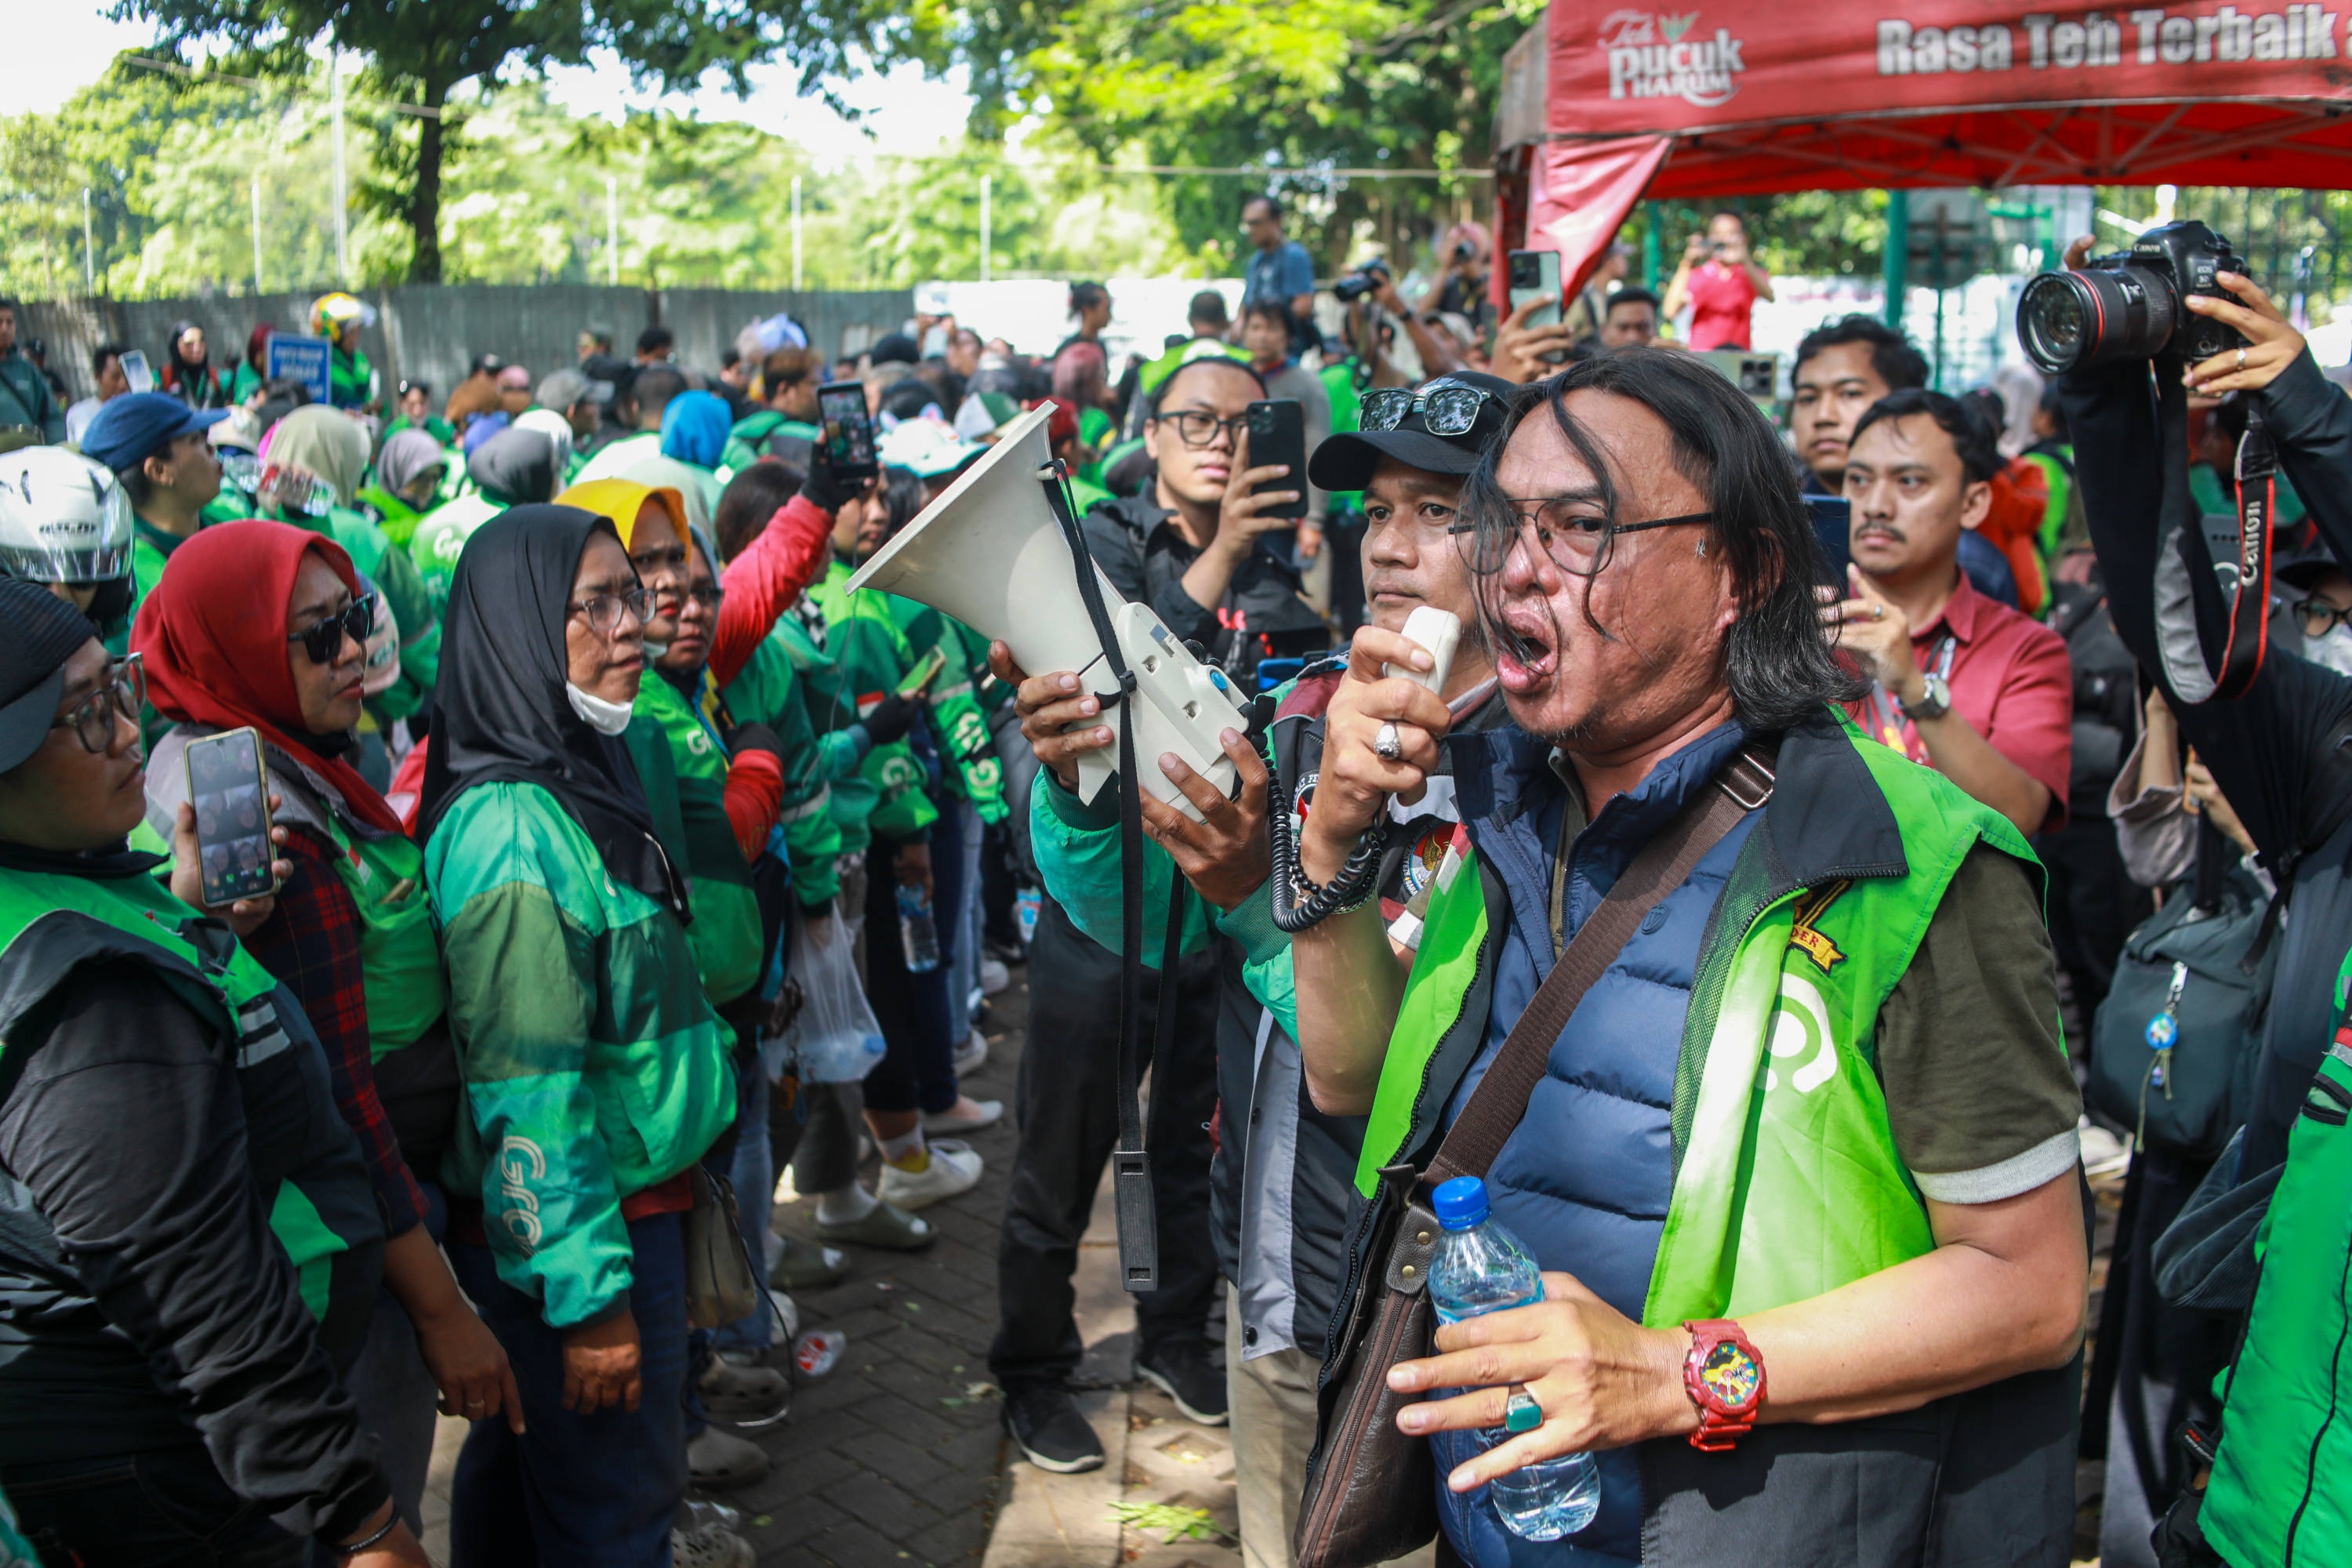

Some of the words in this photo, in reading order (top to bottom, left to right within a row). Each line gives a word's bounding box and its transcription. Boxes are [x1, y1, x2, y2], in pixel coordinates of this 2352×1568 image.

[1877, 19, 2013, 74] Rasa
[2023, 12, 2121, 70] Teh
[2129, 3, 2338, 65] Terbaik
[2133, 244, 2161, 252] Canon
[2241, 500, 2261, 586] Canon
